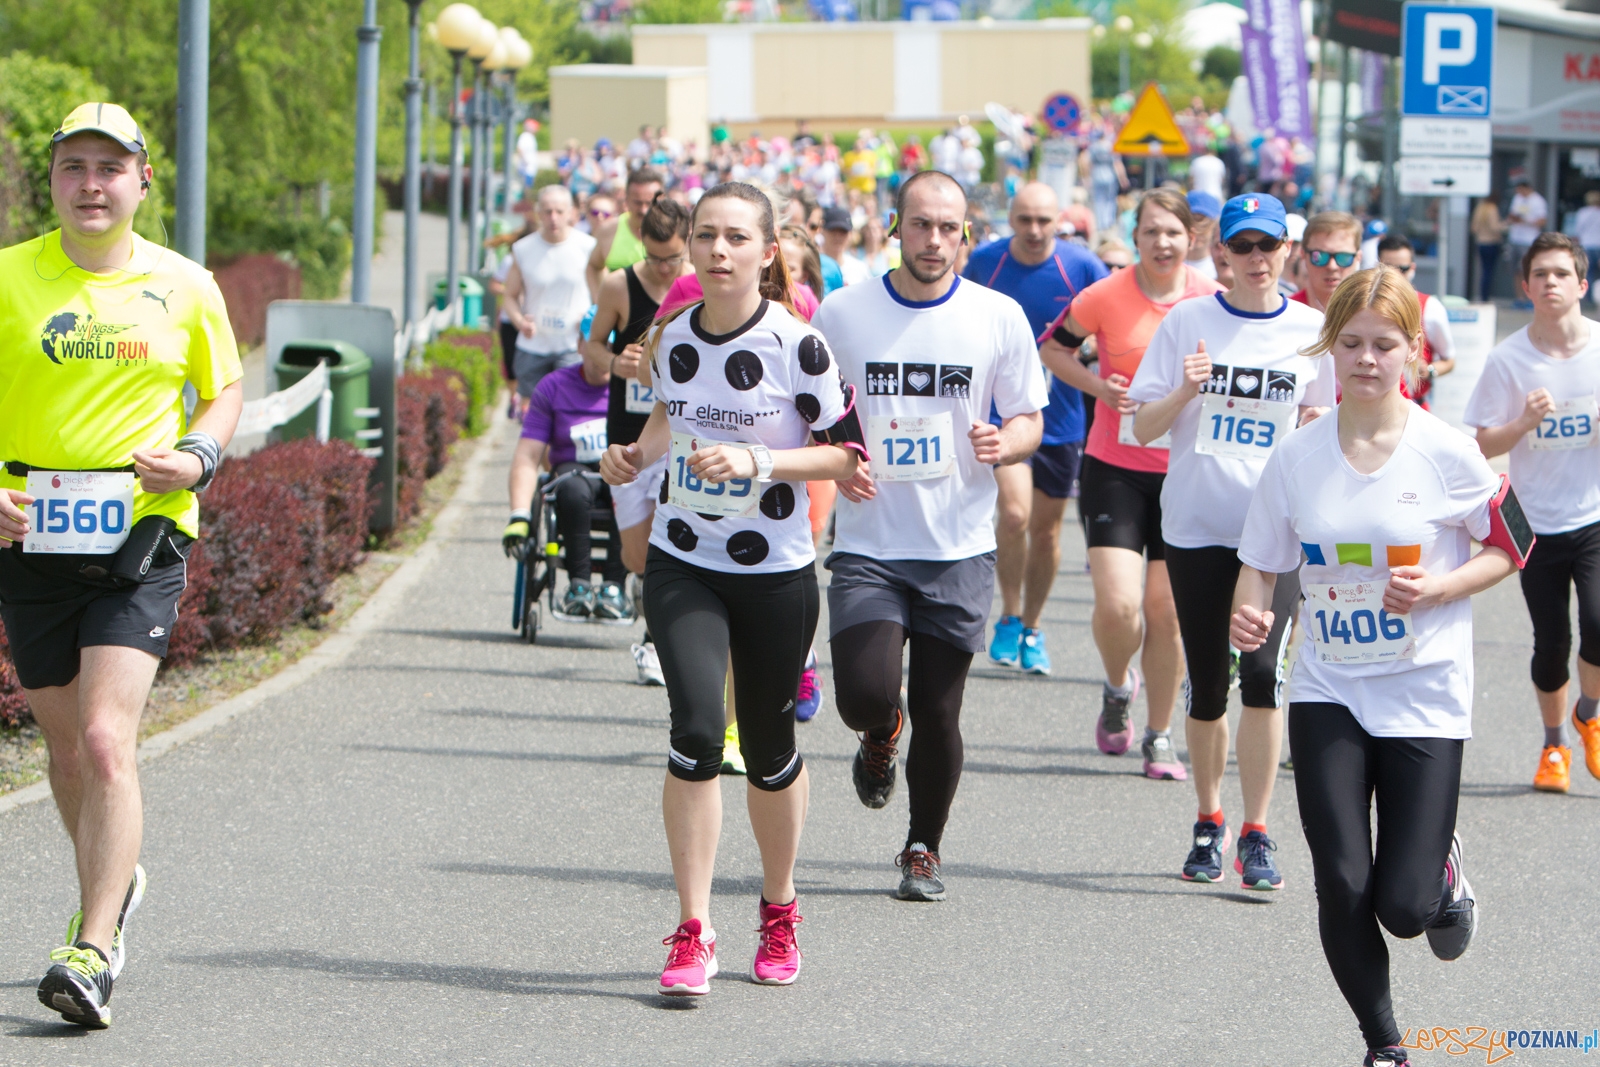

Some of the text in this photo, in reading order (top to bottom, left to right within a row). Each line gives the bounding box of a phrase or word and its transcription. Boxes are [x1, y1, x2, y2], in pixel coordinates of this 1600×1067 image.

[1423, 12, 1477, 85] P
[61, 341, 148, 359] WORLD RUN
[631, 383, 659, 401] 12
[1211, 414, 1276, 448] 1163
[882, 436, 941, 465] 1211
[32, 499, 125, 534] 1560
[1315, 608, 1406, 645] 1406
